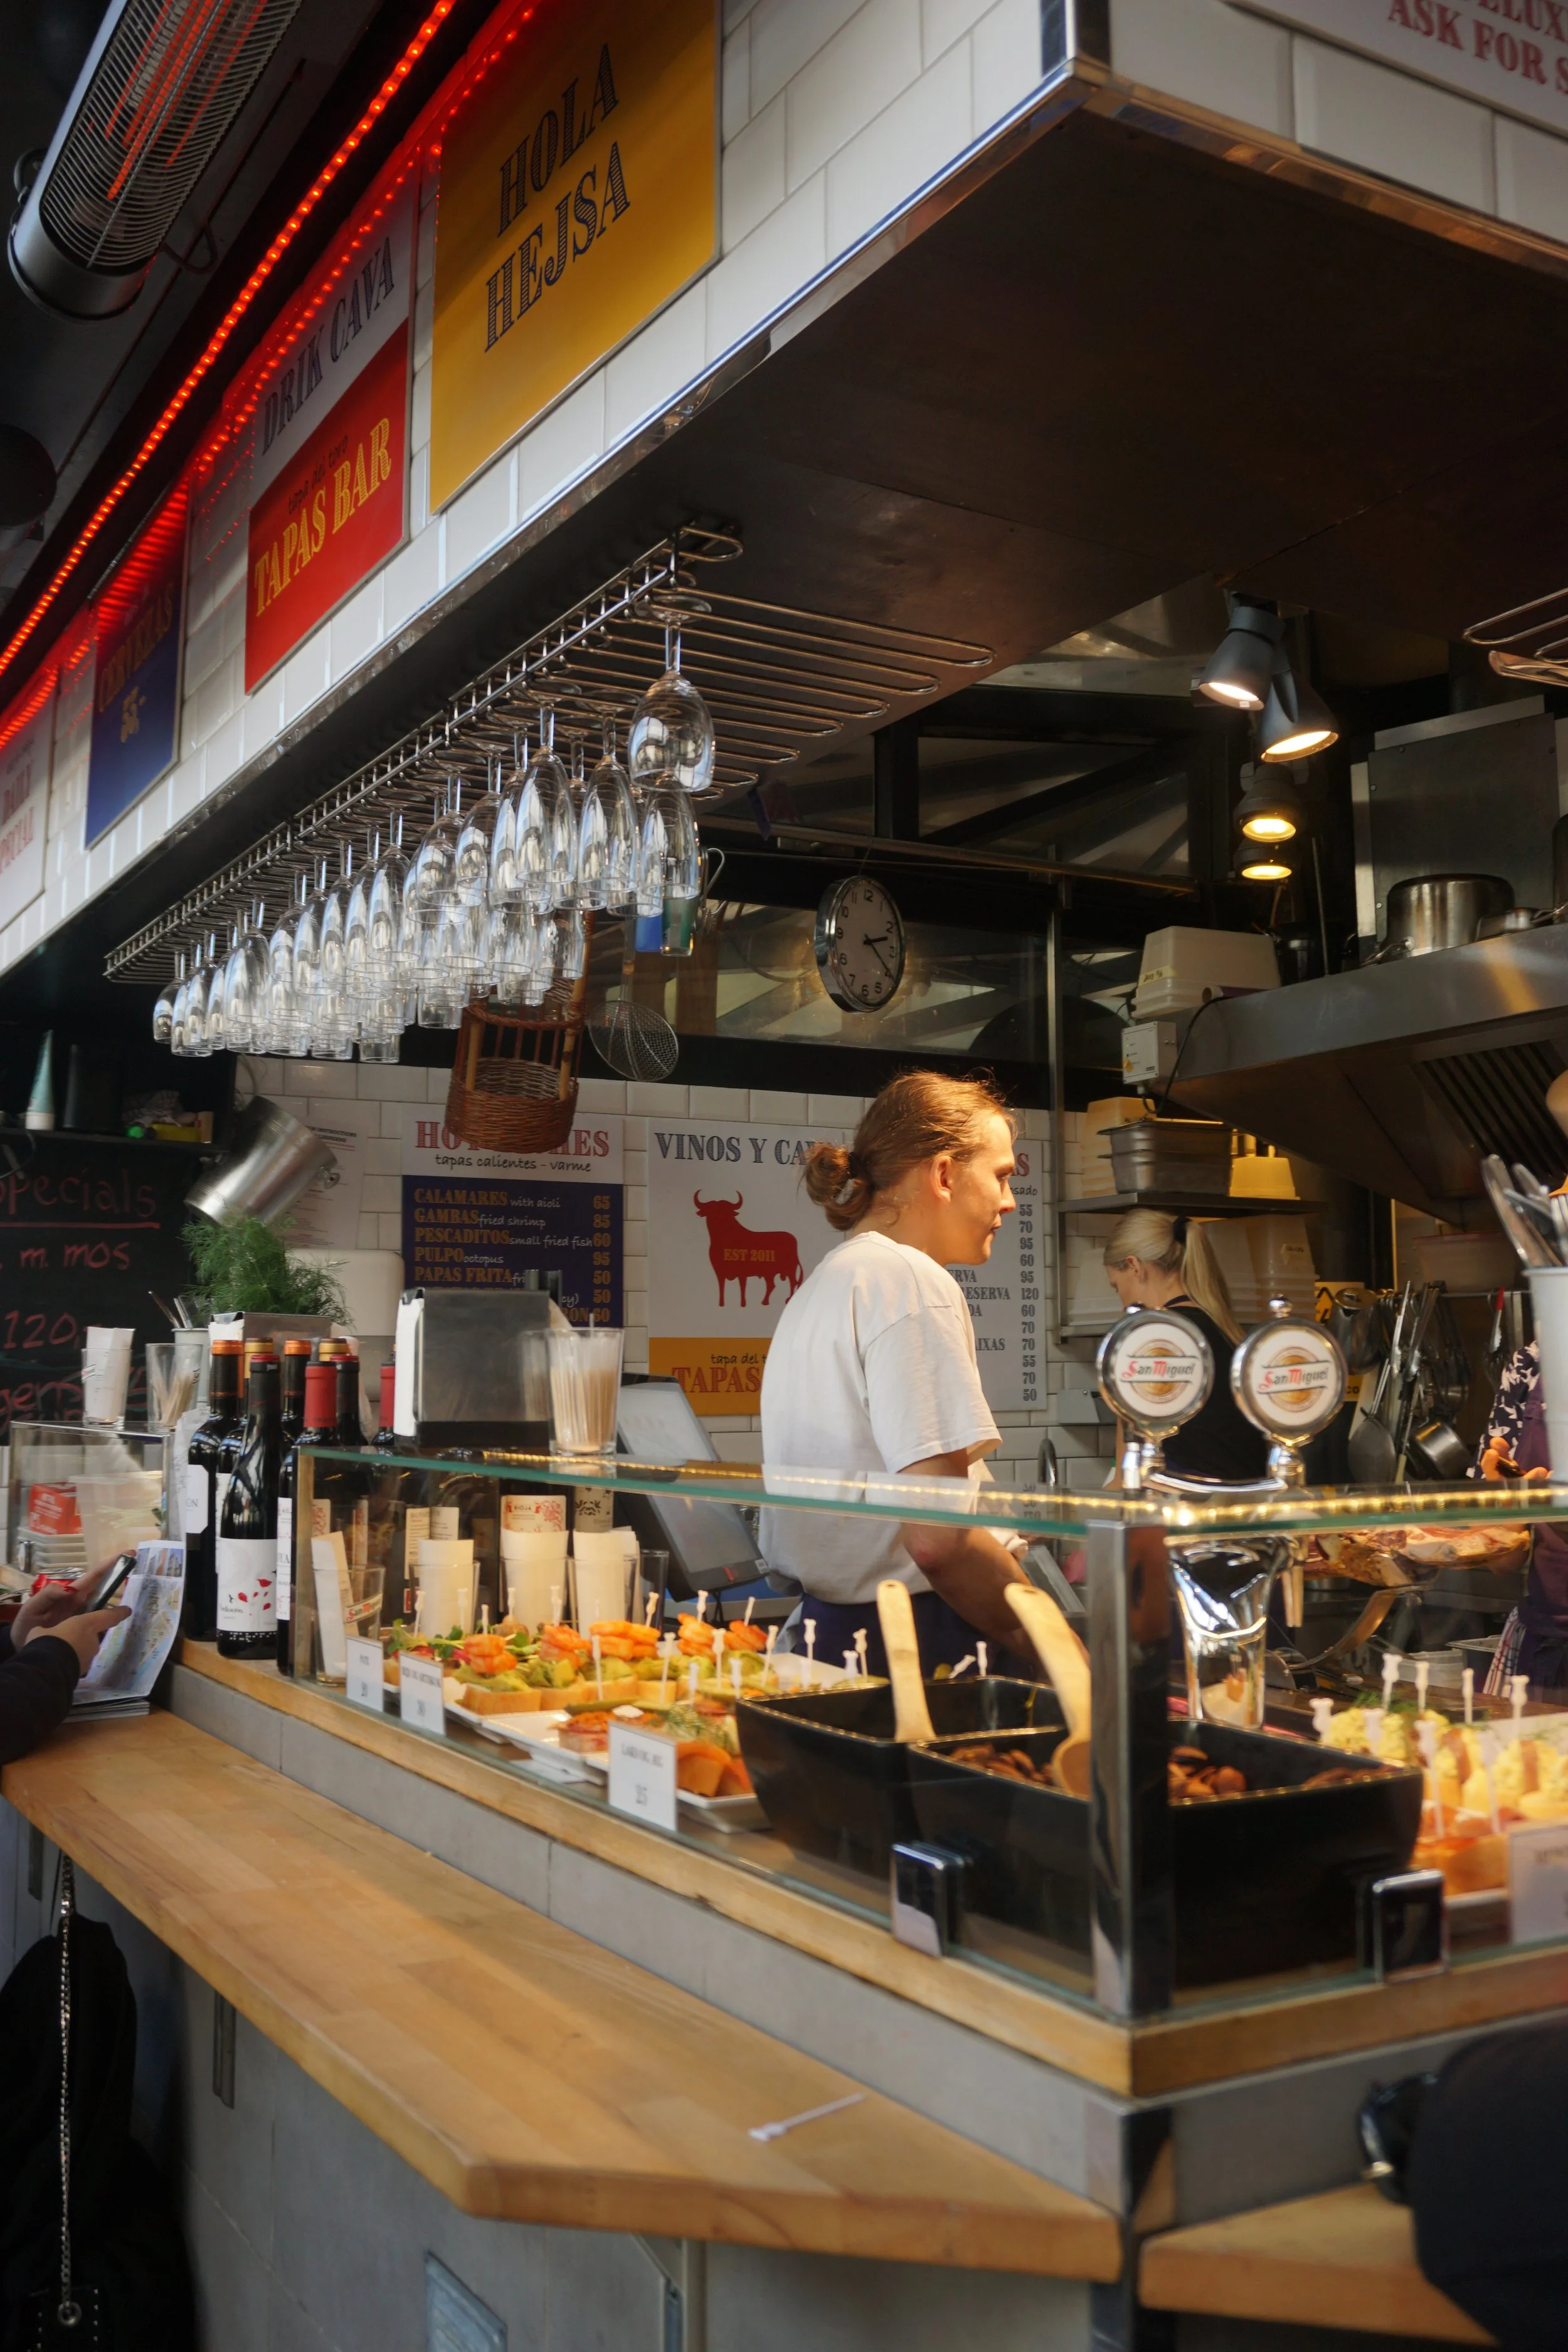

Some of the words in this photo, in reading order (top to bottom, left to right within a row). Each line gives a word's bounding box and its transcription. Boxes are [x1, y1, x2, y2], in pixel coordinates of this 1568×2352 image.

[1388, 0, 1464, 51] ASK
[1473, 19, 1547, 85] FOR
[497, 43, 618, 238] HOLA
[485, 141, 631, 352] HEJSA
[262, 324, 323, 455] DRIK
[331, 236, 395, 363] CAVA
[255, 489, 326, 617] TAPAS
[332, 418, 391, 534] BAR
[864, 889, 874, 902] 12
[841, 905, 849, 918] 10
[836, 927, 844, 940] 9
[886, 921, 894, 934] 2
[839, 953, 848, 965] 8
[849, 973, 856, 986] 7
[861, 983, 869, 997] 6
[874, 982, 882, 994] 5
[654, 1133, 741, 1162] VINOS
[748, 1138, 768, 1163] Y
[435, 1154, 473, 1170] tapas
[477, 1155, 537, 1169] calientes
[550, 1161, 591, 1172] varme
[0, 1168, 157, 1218] pecials
[414, 1188, 508, 1206] CALAMARES
[510, 1196, 534, 1207] with
[537, 1197, 561, 1208] aioli
[593, 1195, 611, 1210] 65
[1019, 1204, 1033, 1217] 55
[414, 1207, 479, 1224] GAMBAS
[478, 1214, 504, 1228] fried
[507, 1216, 546, 1230] shrimp
[593, 1214, 611, 1229] 85
[1019, 1221, 1033, 1233] 70
[414, 1227, 510, 1244] PESCADITOS
[509, 1236, 541, 1246] small
[543, 1235, 569, 1249] fried
[571, 1236, 593, 1250] fish
[593, 1232, 612, 1248] 60
[1020, 1237, 1034, 1250] 95
[414, 1247, 465, 1263] PULPO
[463, 1255, 504, 1267] octopus
[593, 1251, 610, 1266] 95
[723, 1248, 748, 1261] EST
[750, 1249, 776, 1262] 2011
[1020, 1254, 1034, 1266] 60
[414, 1266, 462, 1282] PAPAS
[465, 1267, 513, 1283] FRITA
[593, 1271, 611, 1285] 50
[1020, 1271, 1034, 1283] 95
[593, 1289, 611, 1303] 50
[1021, 1287, 1039, 1300] 120
[593, 1308, 611, 1323] 60
[1021, 1305, 1036, 1317] 60
[1022, 1322, 1035, 1334] 70
[1022, 1338, 1036, 1351] 70
[711, 1354, 738, 1368] tapa
[741, 1352, 759, 1364] del
[1022, 1355, 1036, 1367] 55
[672, 1367, 761, 1393] TAPAS
[1022, 1372, 1036, 1384] 70
[1022, 1389, 1037, 1401] 50
